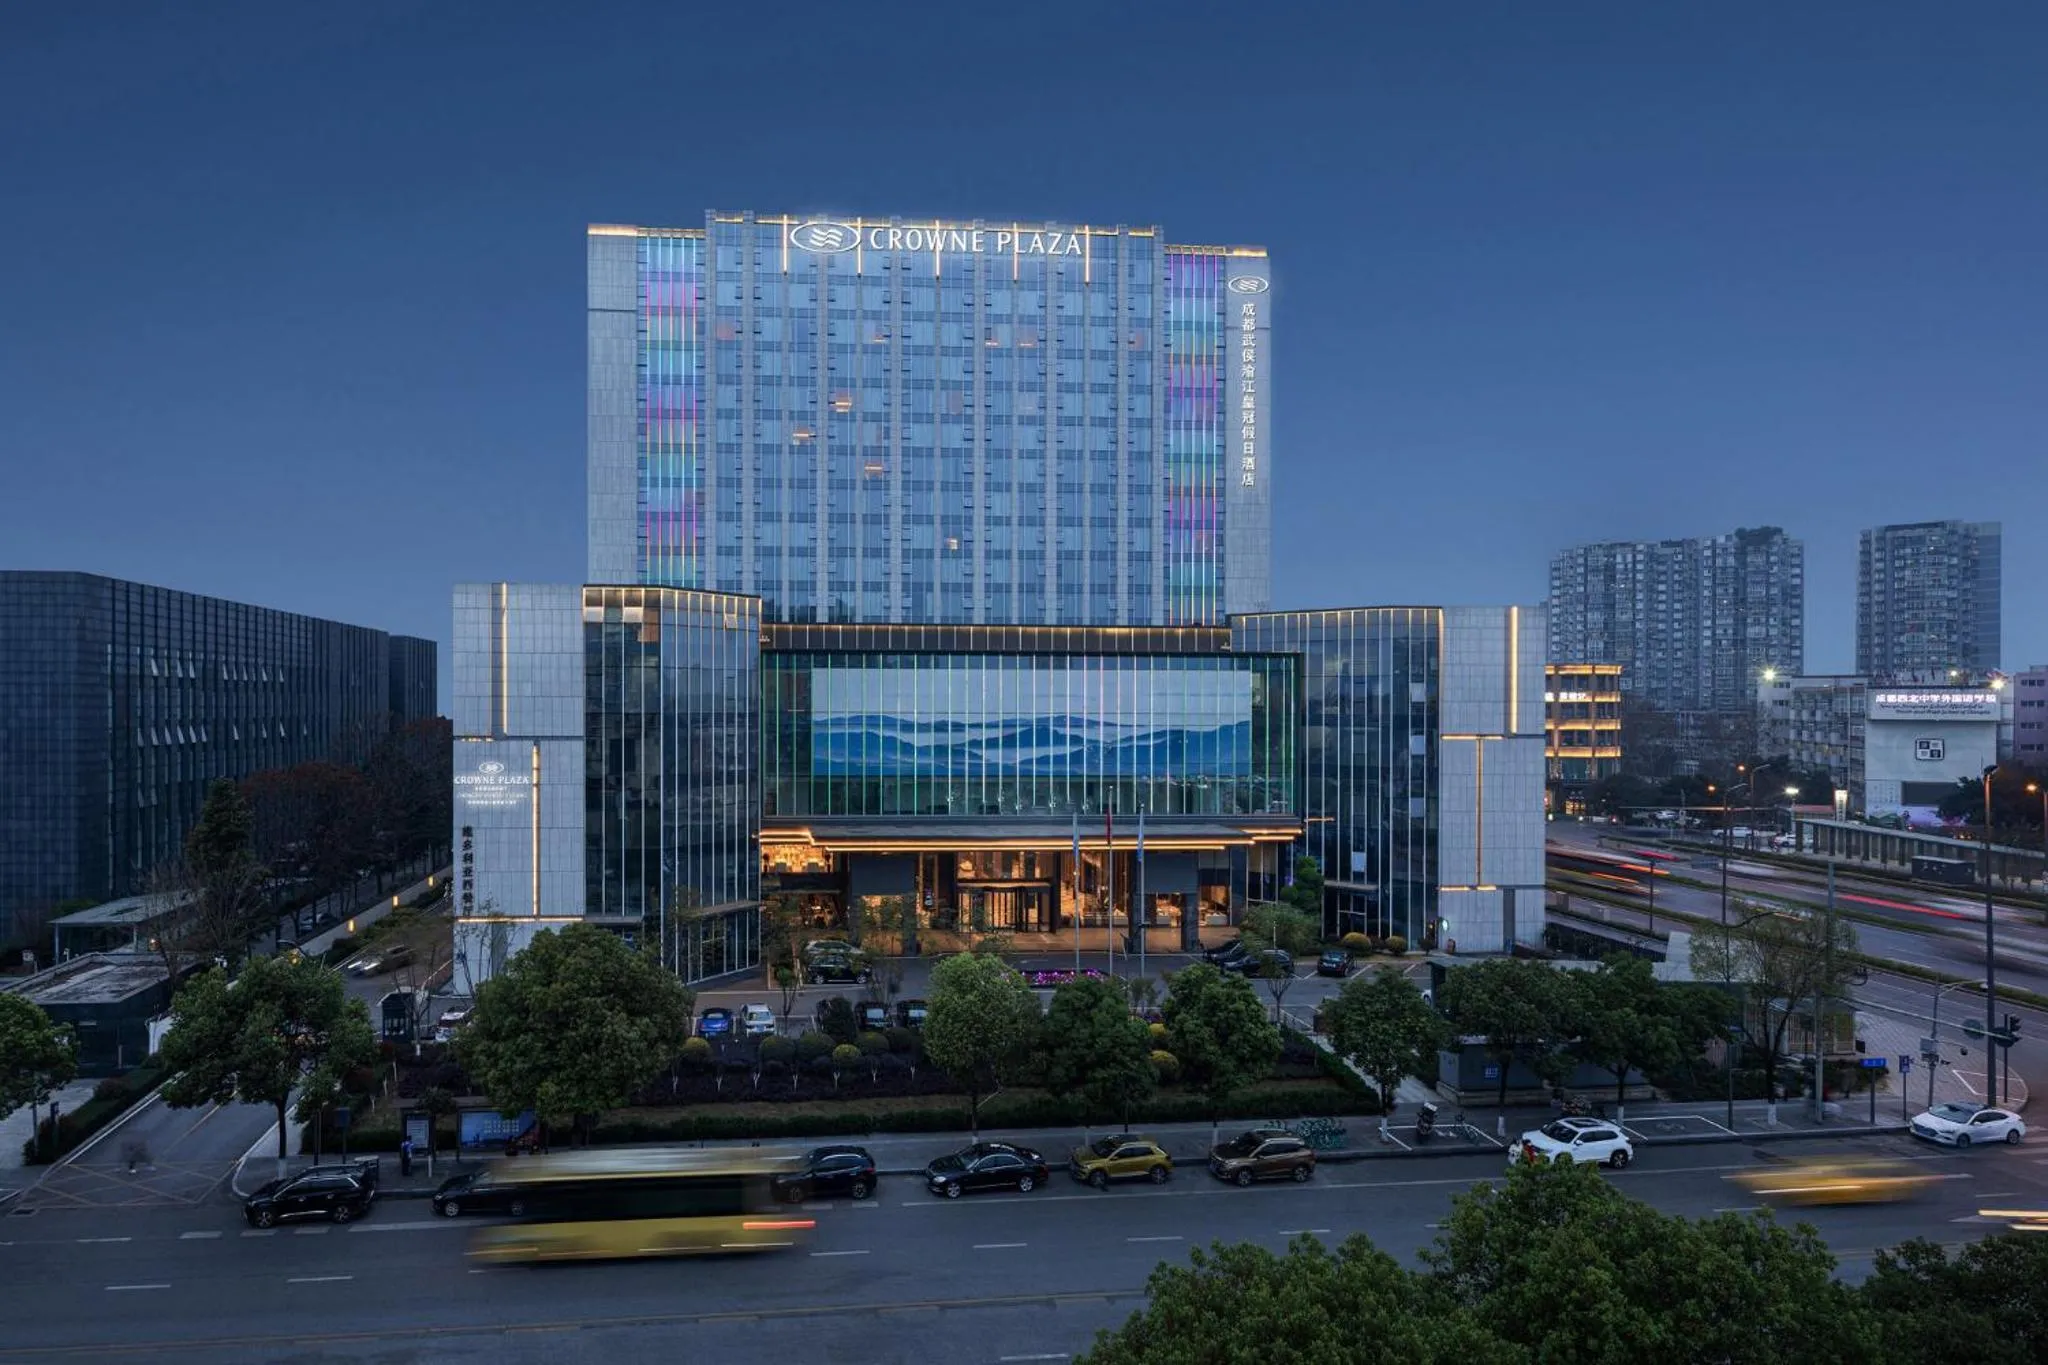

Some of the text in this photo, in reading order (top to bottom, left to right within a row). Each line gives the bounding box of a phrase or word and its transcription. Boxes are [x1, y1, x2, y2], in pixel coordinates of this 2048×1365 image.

[870, 228, 1082, 254] CROWNE PLAZA
[454, 775, 529, 785] CROWNE PLAZA
